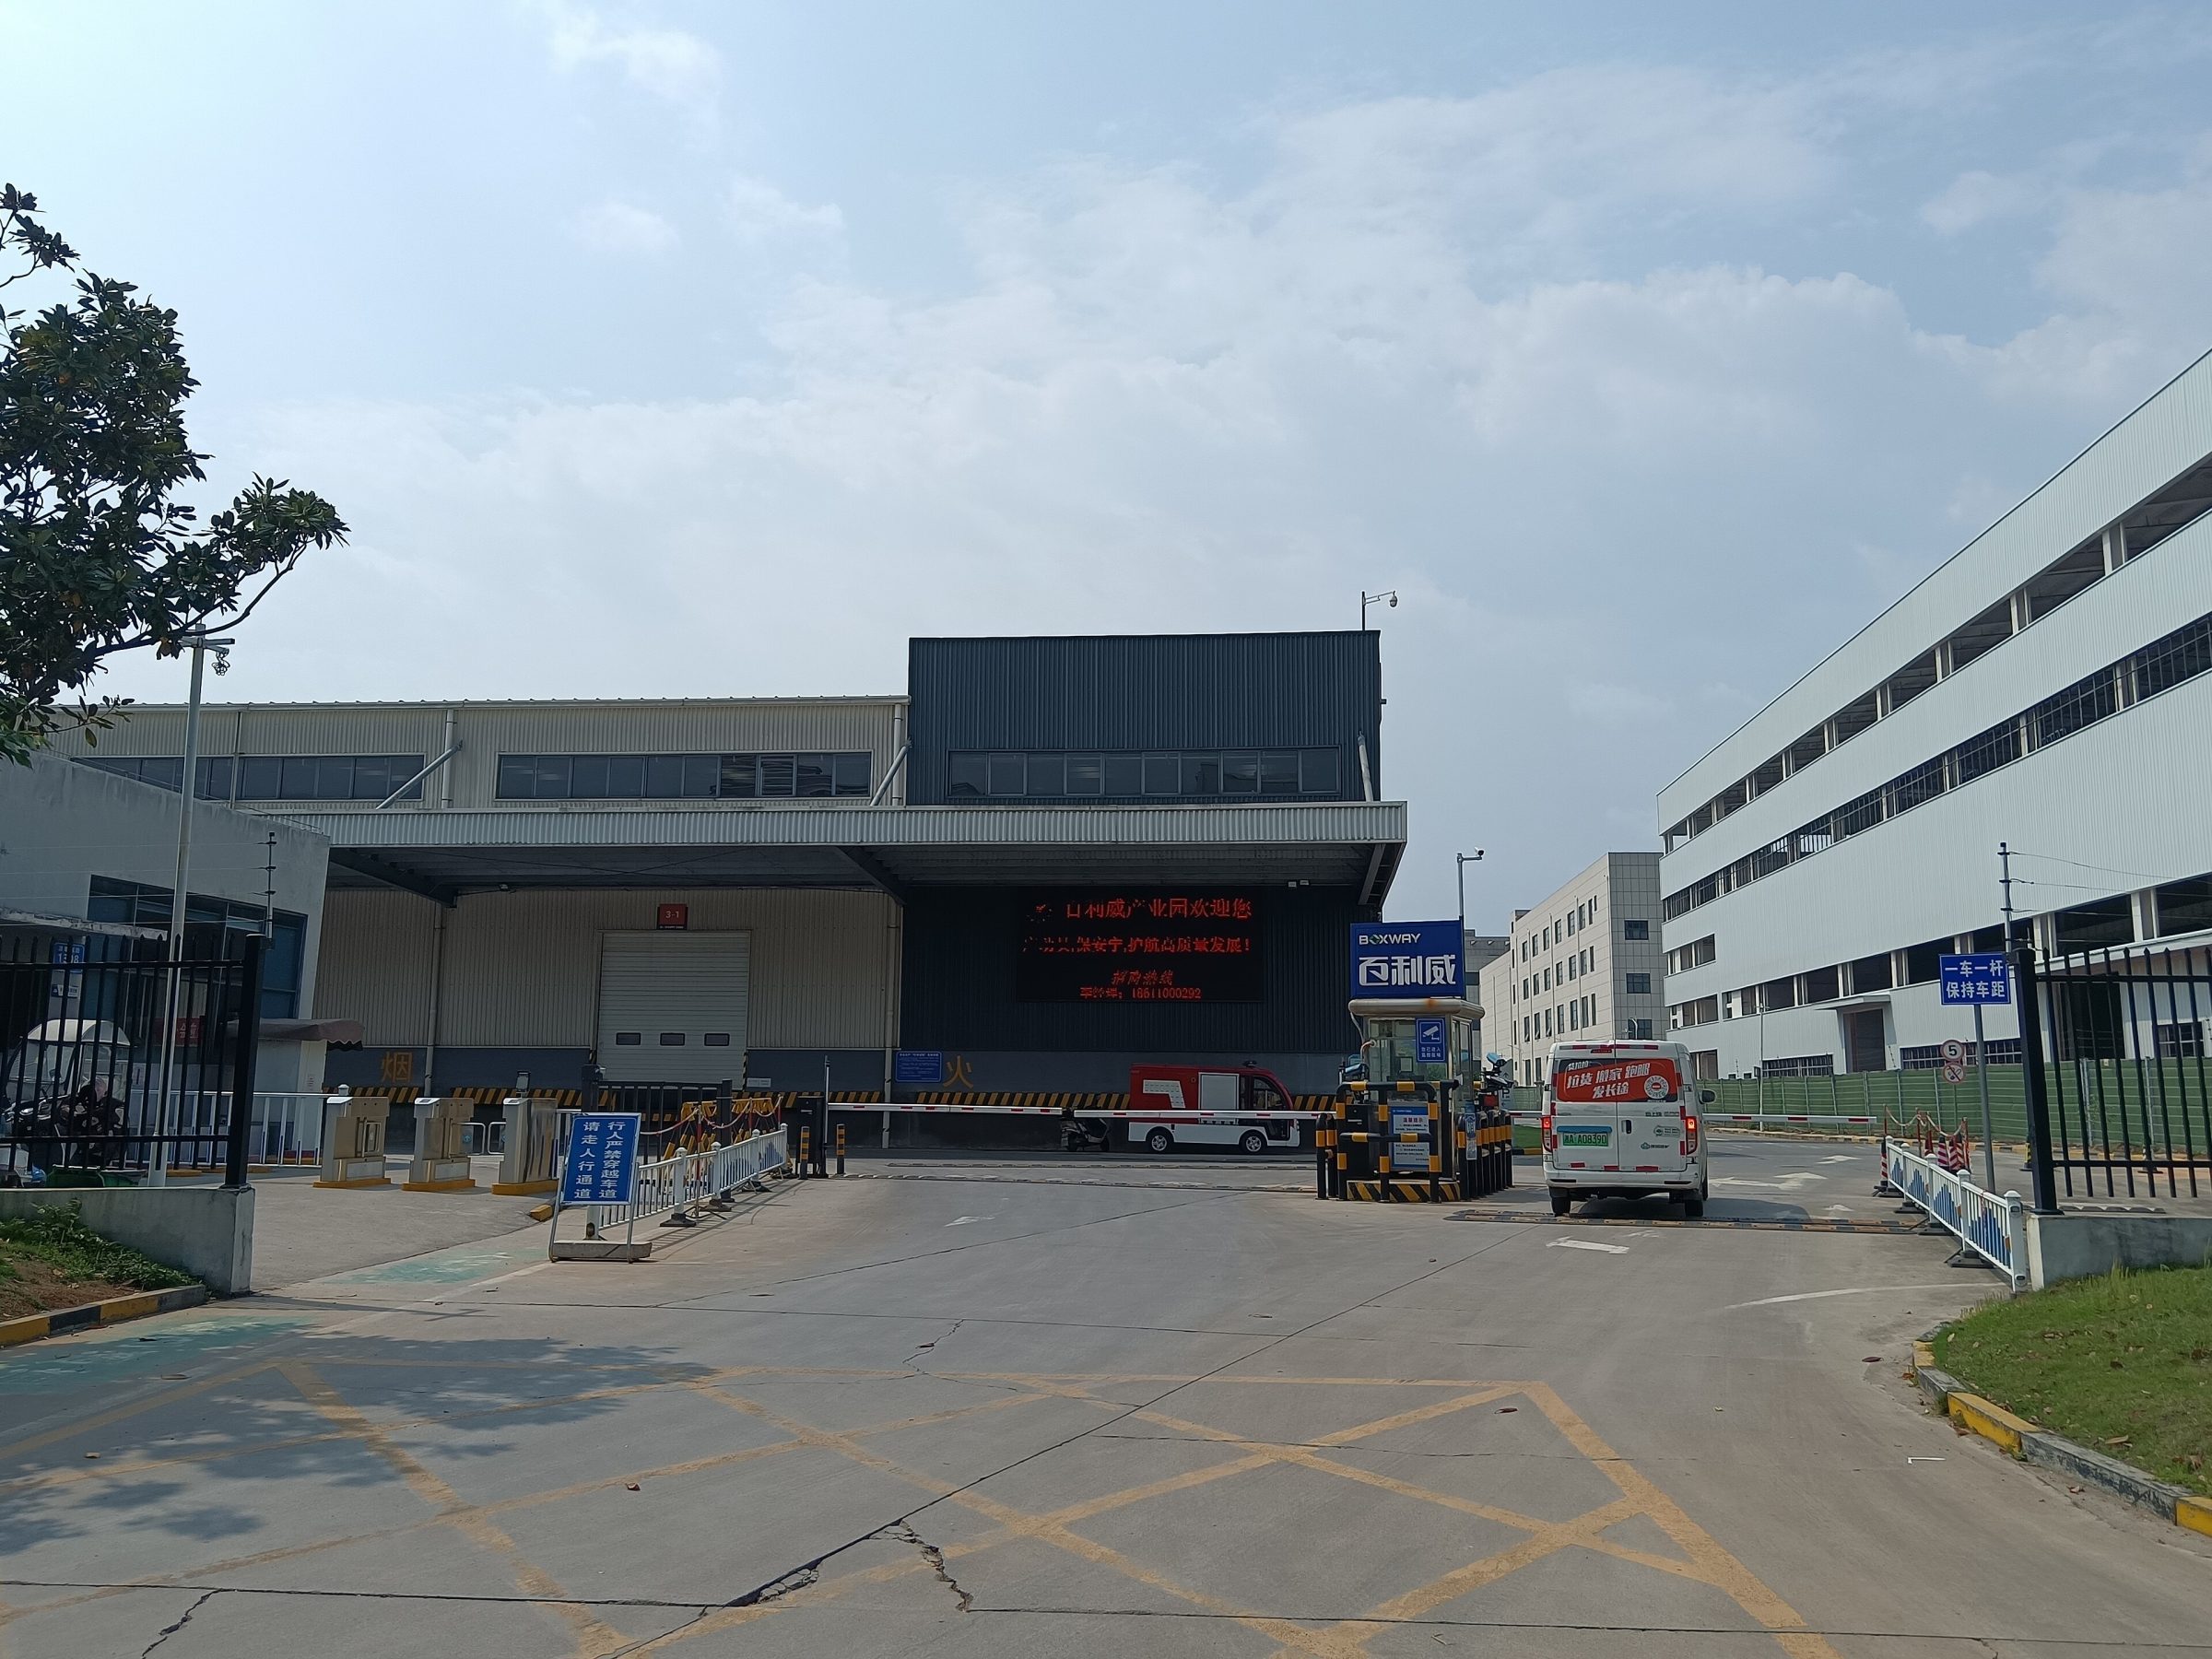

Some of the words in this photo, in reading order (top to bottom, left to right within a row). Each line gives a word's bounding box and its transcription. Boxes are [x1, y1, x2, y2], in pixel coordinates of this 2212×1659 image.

[665, 910, 679, 919] 3-1
[1359, 933, 1421, 945] BOXWAY
[1359, 954, 1456, 986] 百利威
[1945, 959, 2004, 978] 一车一杆
[1132, 987, 1202, 1000] 18611000292
[1947, 981, 2006, 999] 保持车距
[1948, 1044, 1958, 1056] 5
[380, 1051, 413, 1083] 烟
[943, 1054, 973, 1088] 火
[1592, 1081, 1630, 1100] 发长途
[574, 1121, 601, 1199] 请走人行通道
[598, 1121, 626, 1199] 行人严禁穿越车道
